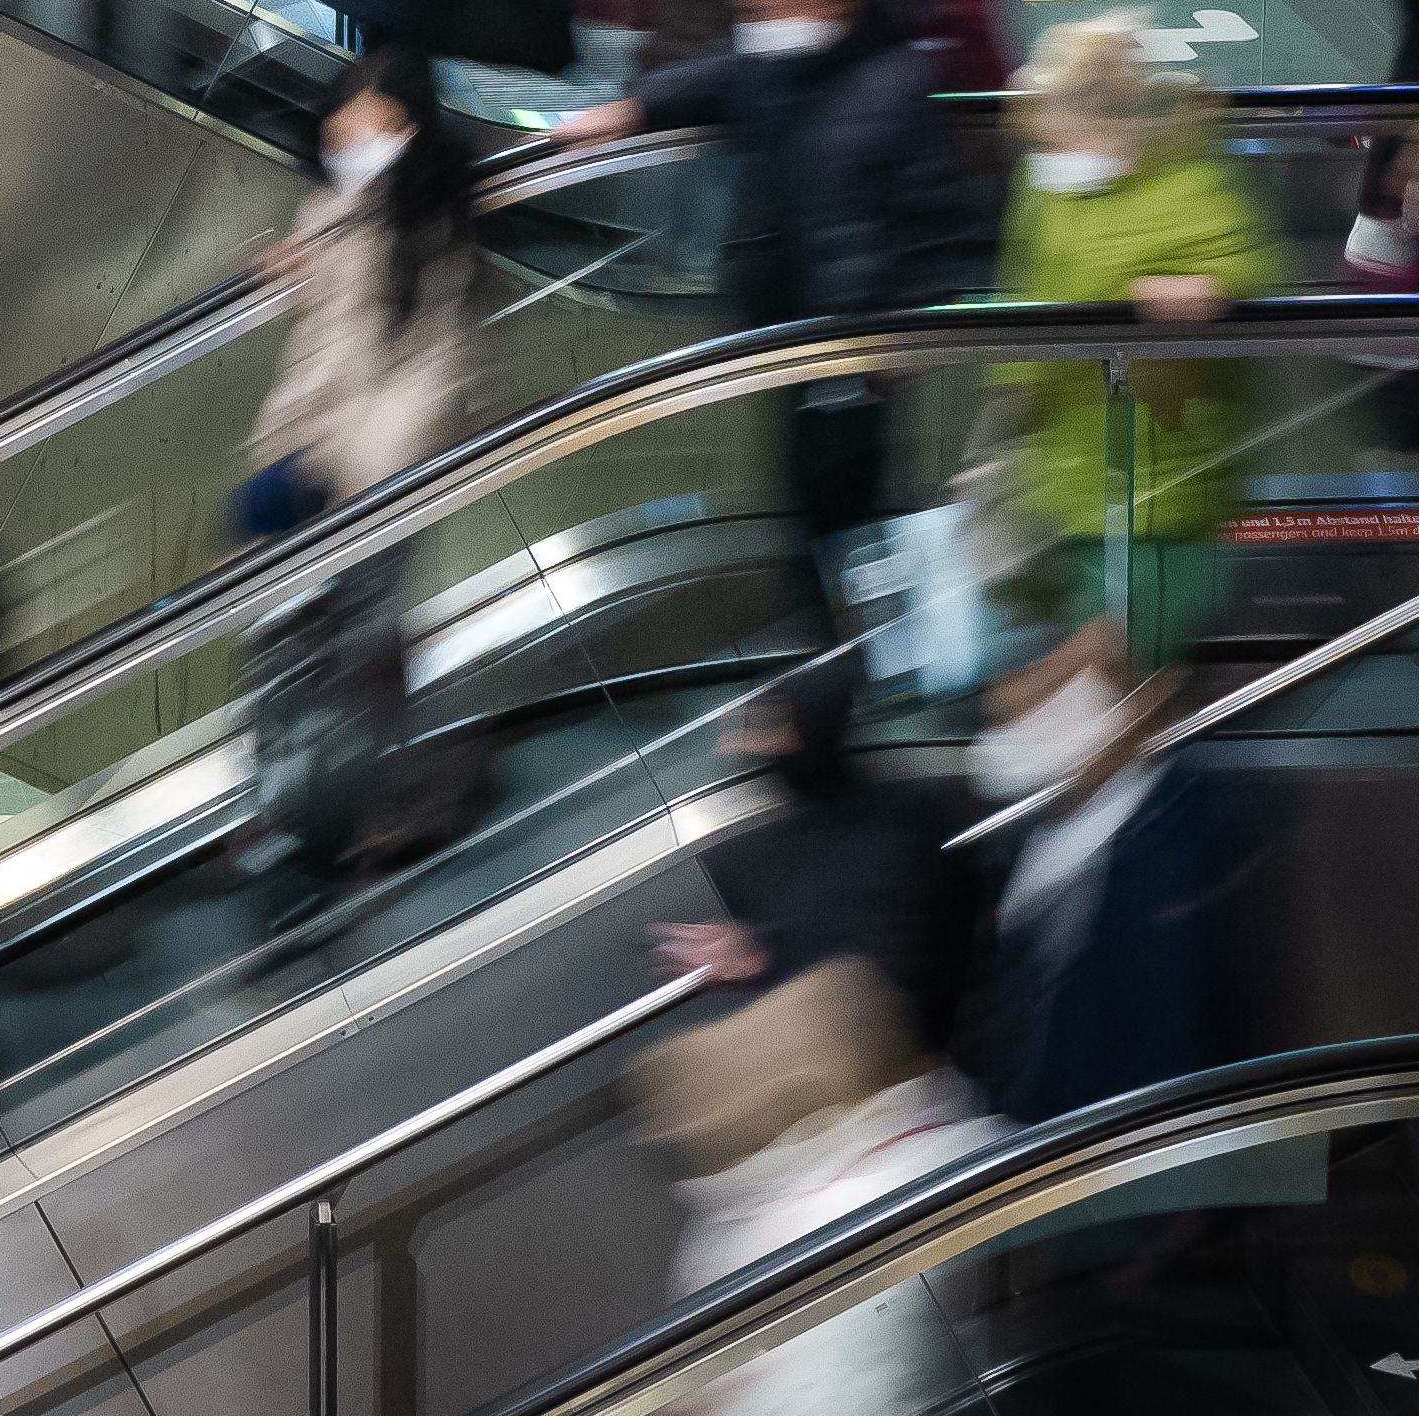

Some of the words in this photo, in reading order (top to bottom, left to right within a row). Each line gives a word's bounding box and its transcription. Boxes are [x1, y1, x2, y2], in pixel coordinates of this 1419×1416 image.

[1241, 517, 1270, 528] und
[1317, 514, 1379, 526] Abstand
[1235, 529, 1308, 542] passengers
[1311, 527, 1338, 538] and
[1342, 526, 1372, 539] keep
